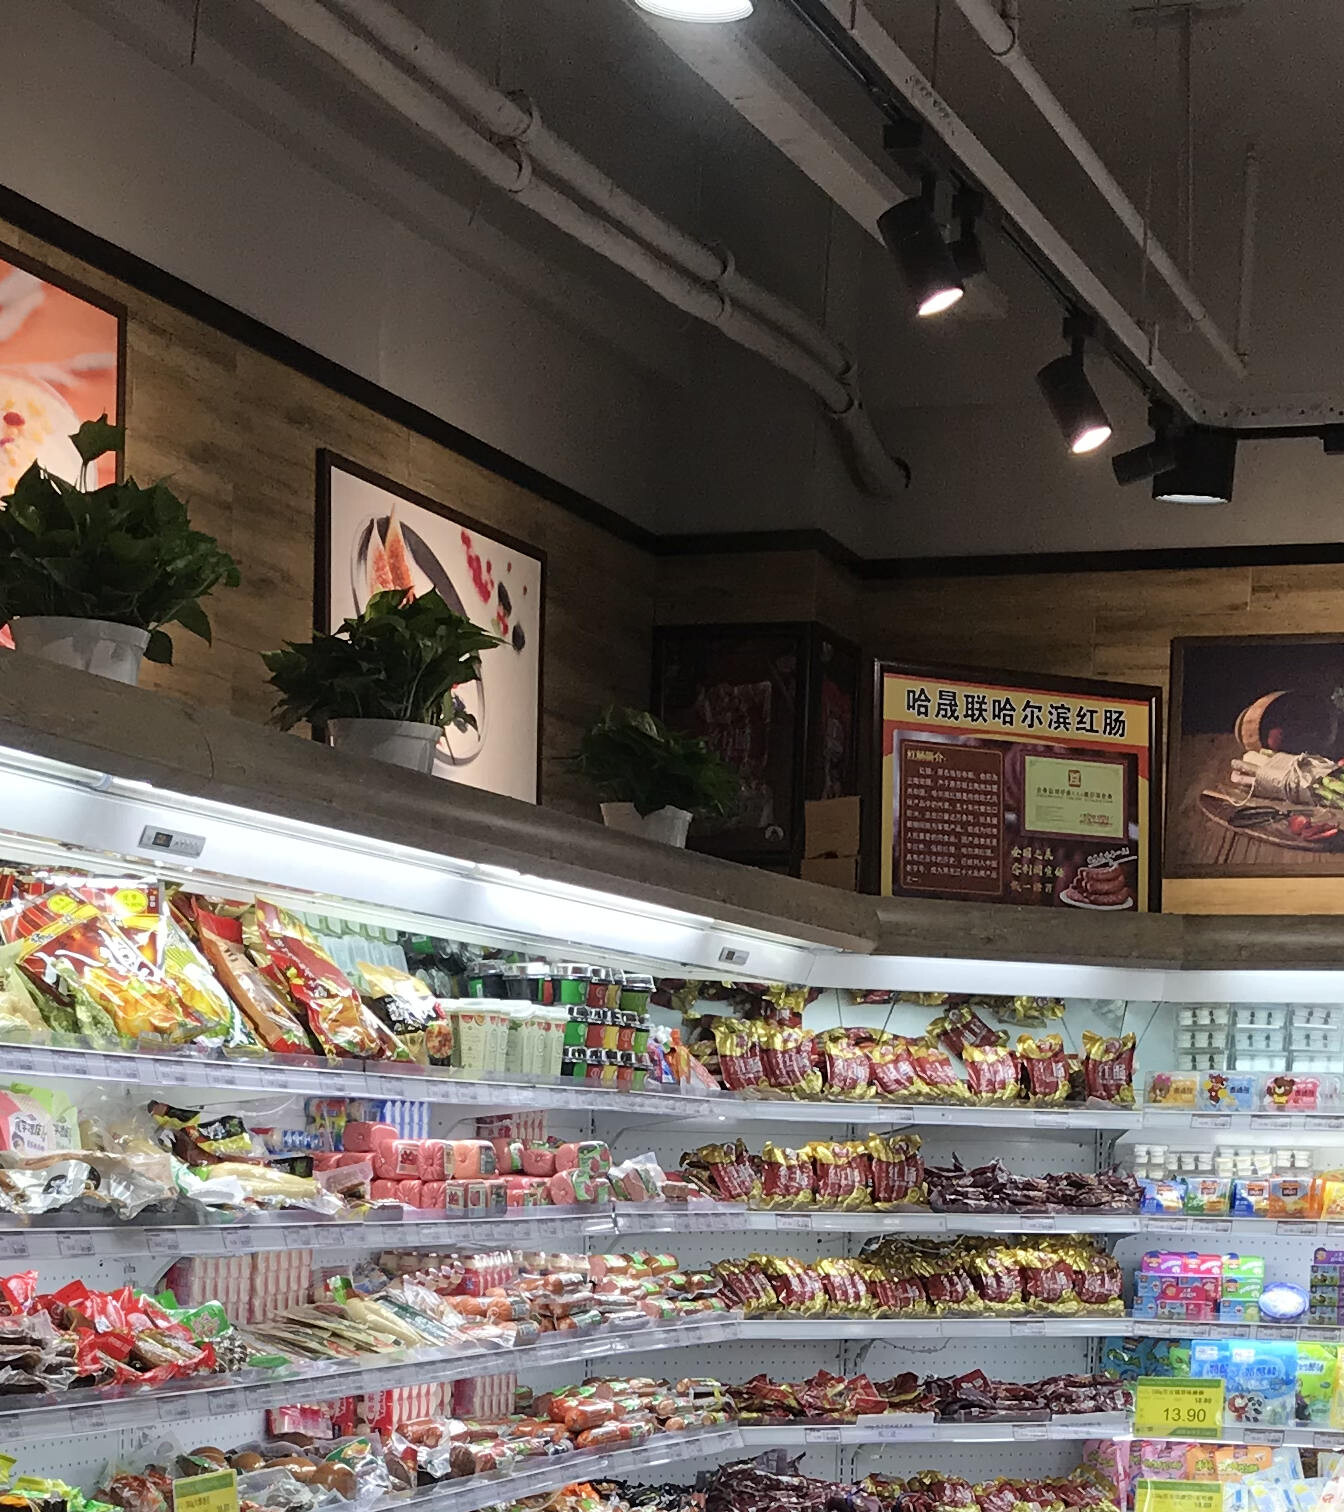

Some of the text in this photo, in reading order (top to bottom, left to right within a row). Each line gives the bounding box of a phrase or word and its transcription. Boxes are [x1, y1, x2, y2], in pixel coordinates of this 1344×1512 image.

[906, 688, 1127, 738] 哈晟联哈尔滨红肠
[1162, 1408, 1206, 1423] 13.90
